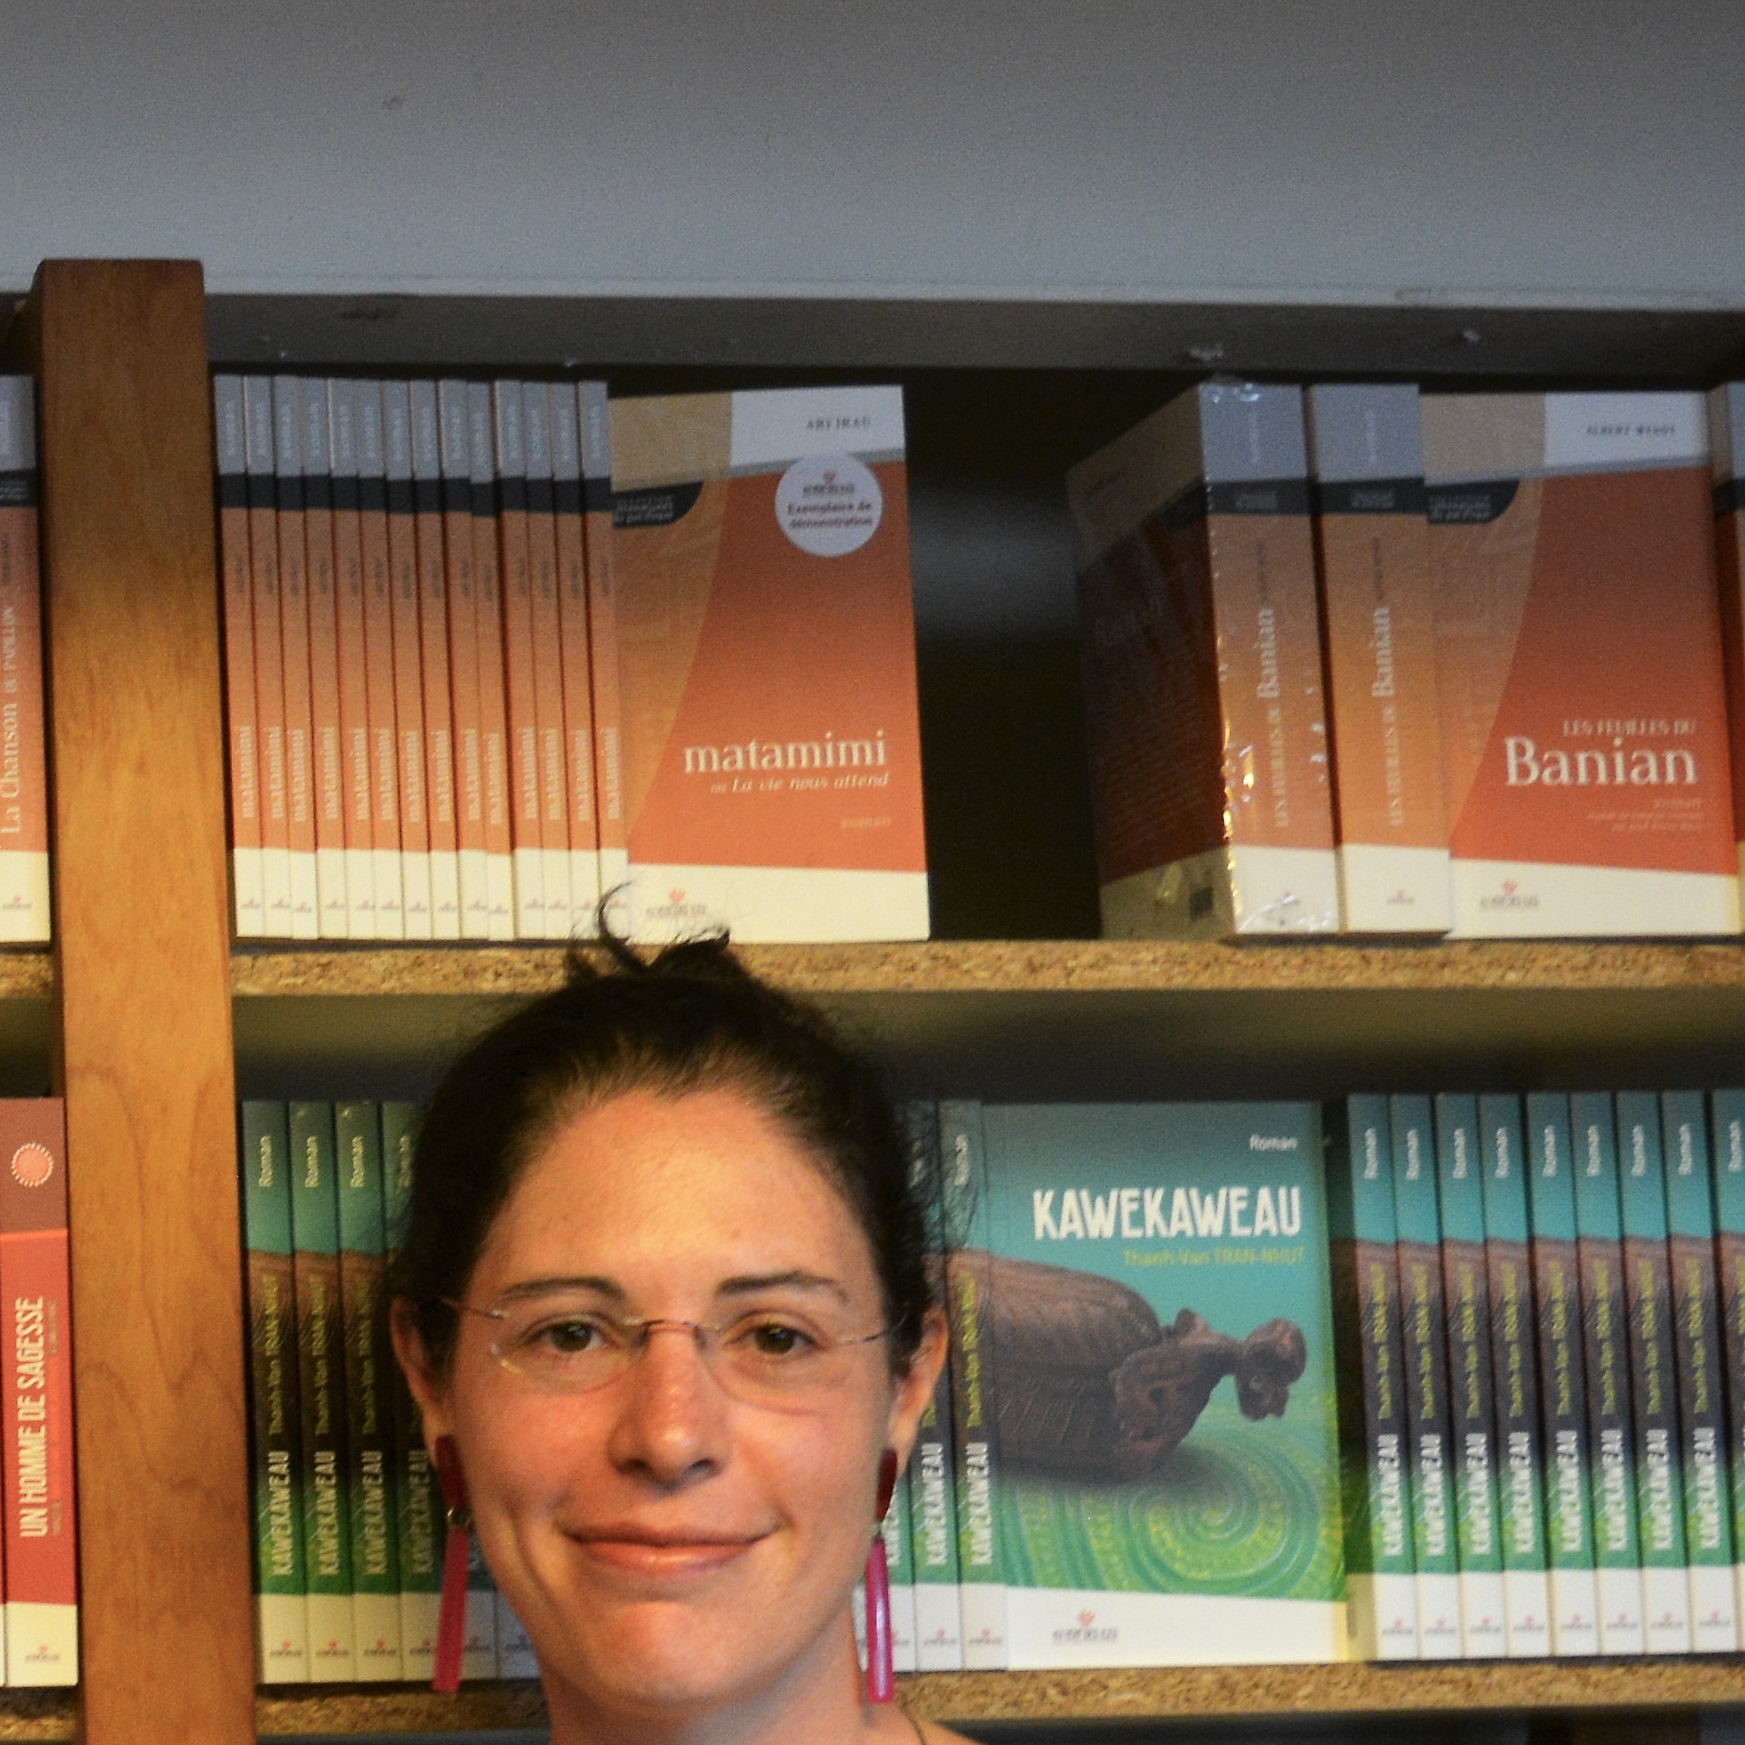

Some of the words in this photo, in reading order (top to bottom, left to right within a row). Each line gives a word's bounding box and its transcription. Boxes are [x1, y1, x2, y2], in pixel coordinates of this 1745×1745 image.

[1250, 607, 1281, 699] Banian
[683, 728, 886, 773] matamimi
[1504, 735, 1698, 786] Banian
[790, 777, 828, 791] nous
[834, 771, 890, 790] attend
[1249, 1135, 1298, 1150] Roman
[1033, 1186, 1301, 1241] KAWEKAWEAU
[15, 1297, 46, 1388] SAGESSE
[17, 1394, 46, 1420] DE
[17, 1424, 47, 1502] HOMME
[268, 1450, 293, 1575] KAWEKAWEAU
[1599, 1429, 1630, 1551] KAWEKAWEAU
[18, 1507, 48, 1536] UN
